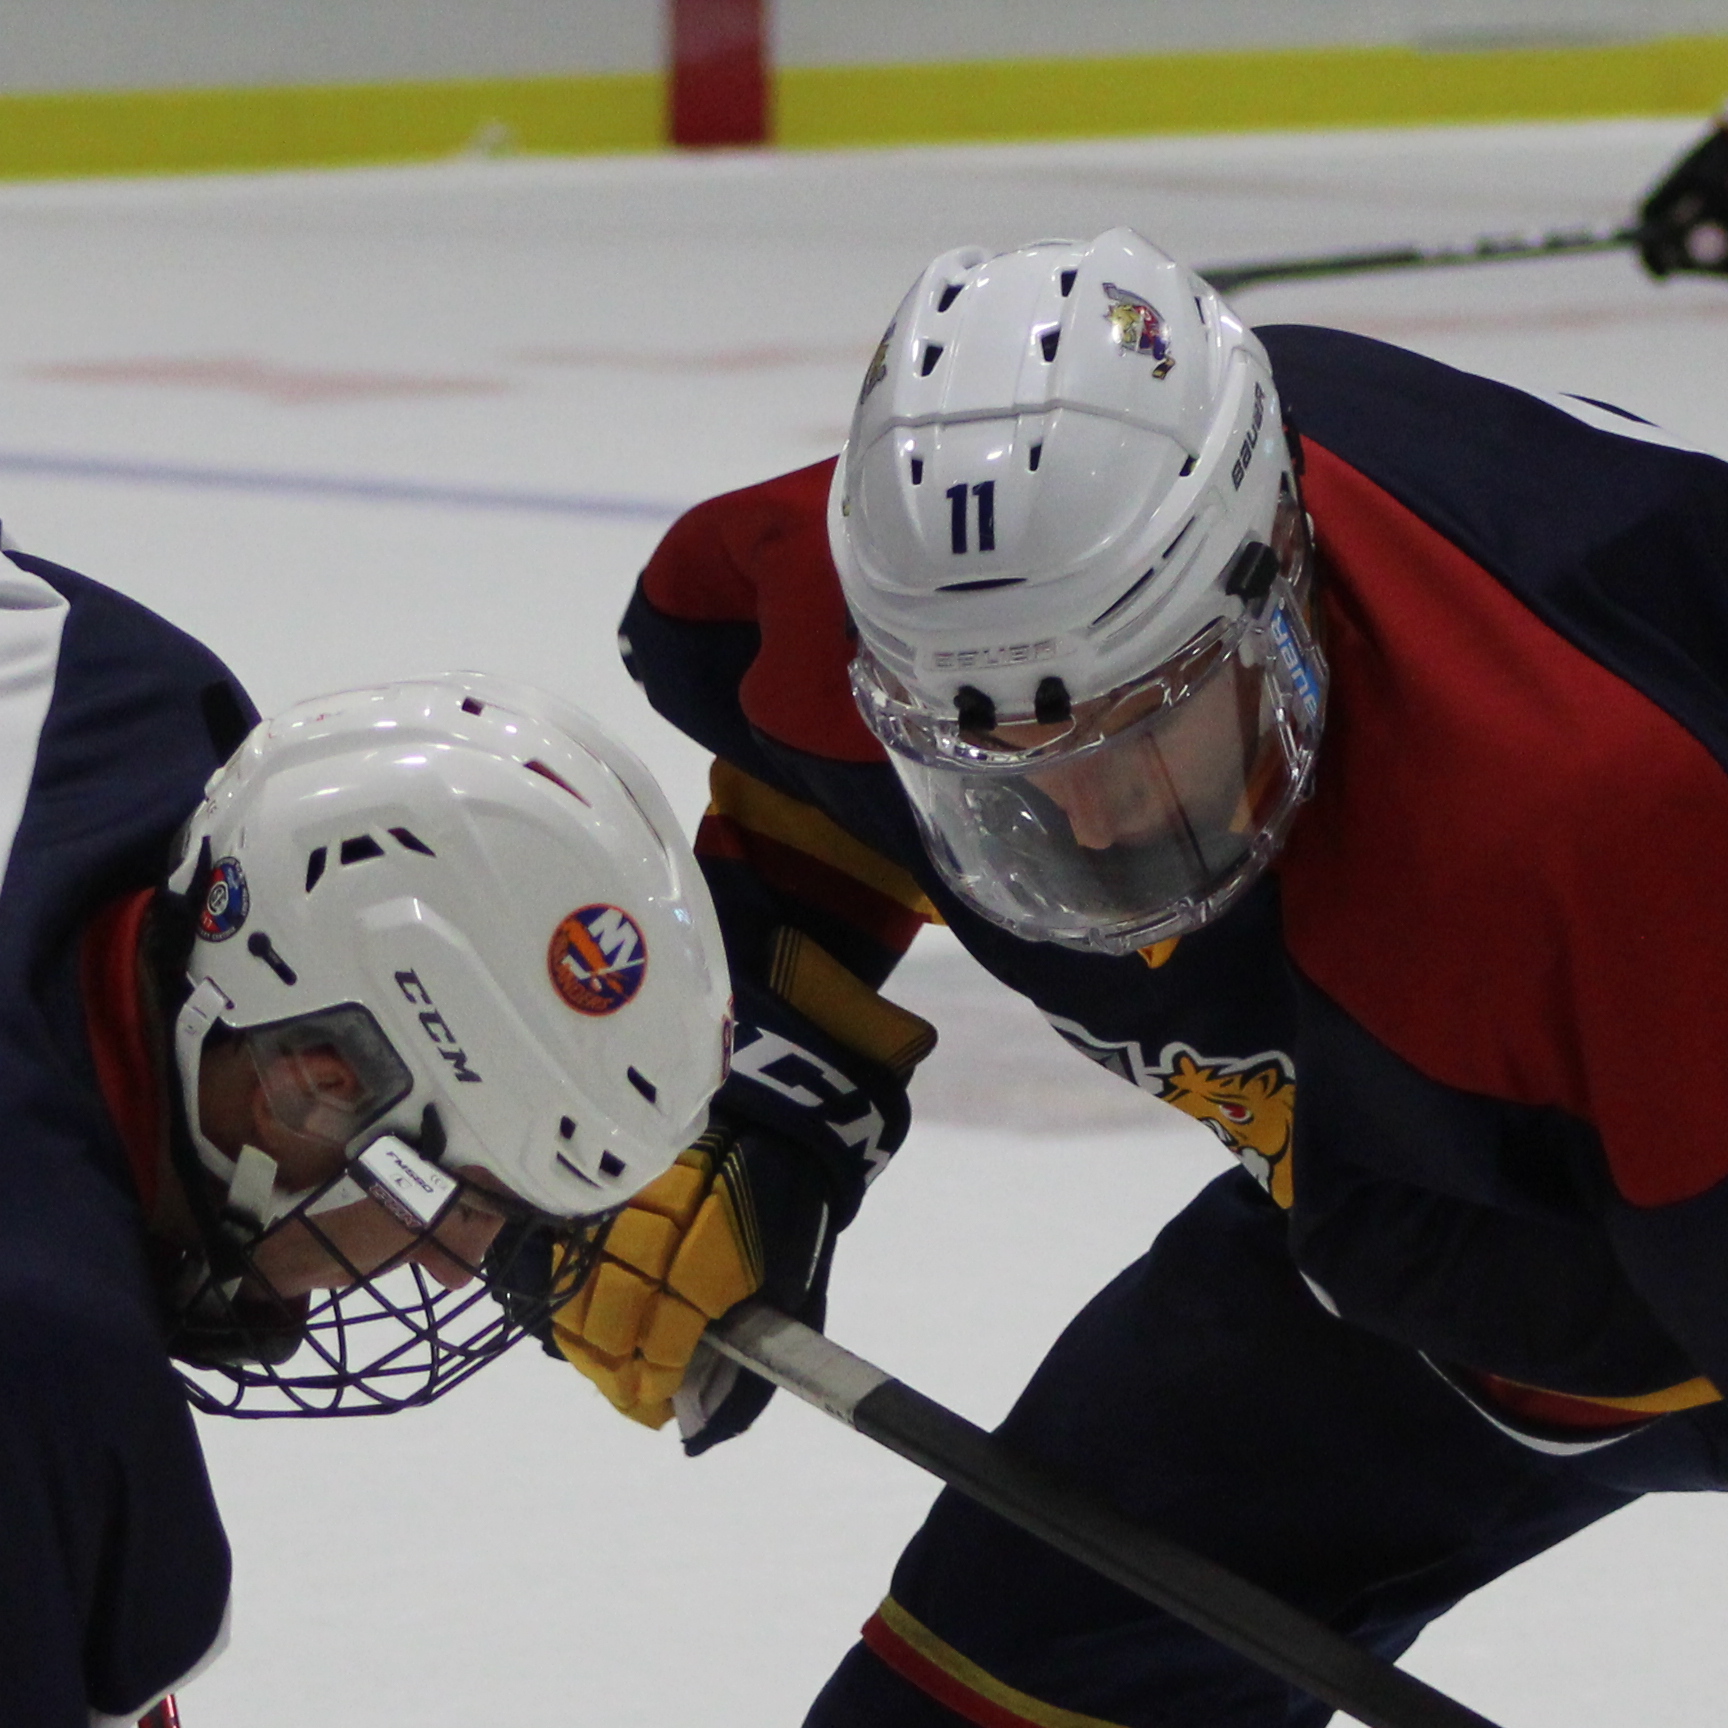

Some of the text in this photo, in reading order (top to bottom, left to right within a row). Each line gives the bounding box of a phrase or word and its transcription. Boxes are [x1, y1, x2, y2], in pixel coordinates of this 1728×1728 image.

[1231, 381, 1265, 492] BAUER
[946, 480, 996, 554] 11
[394, 967, 483, 1082] CCM
[730, 1020, 892, 1188] CM
